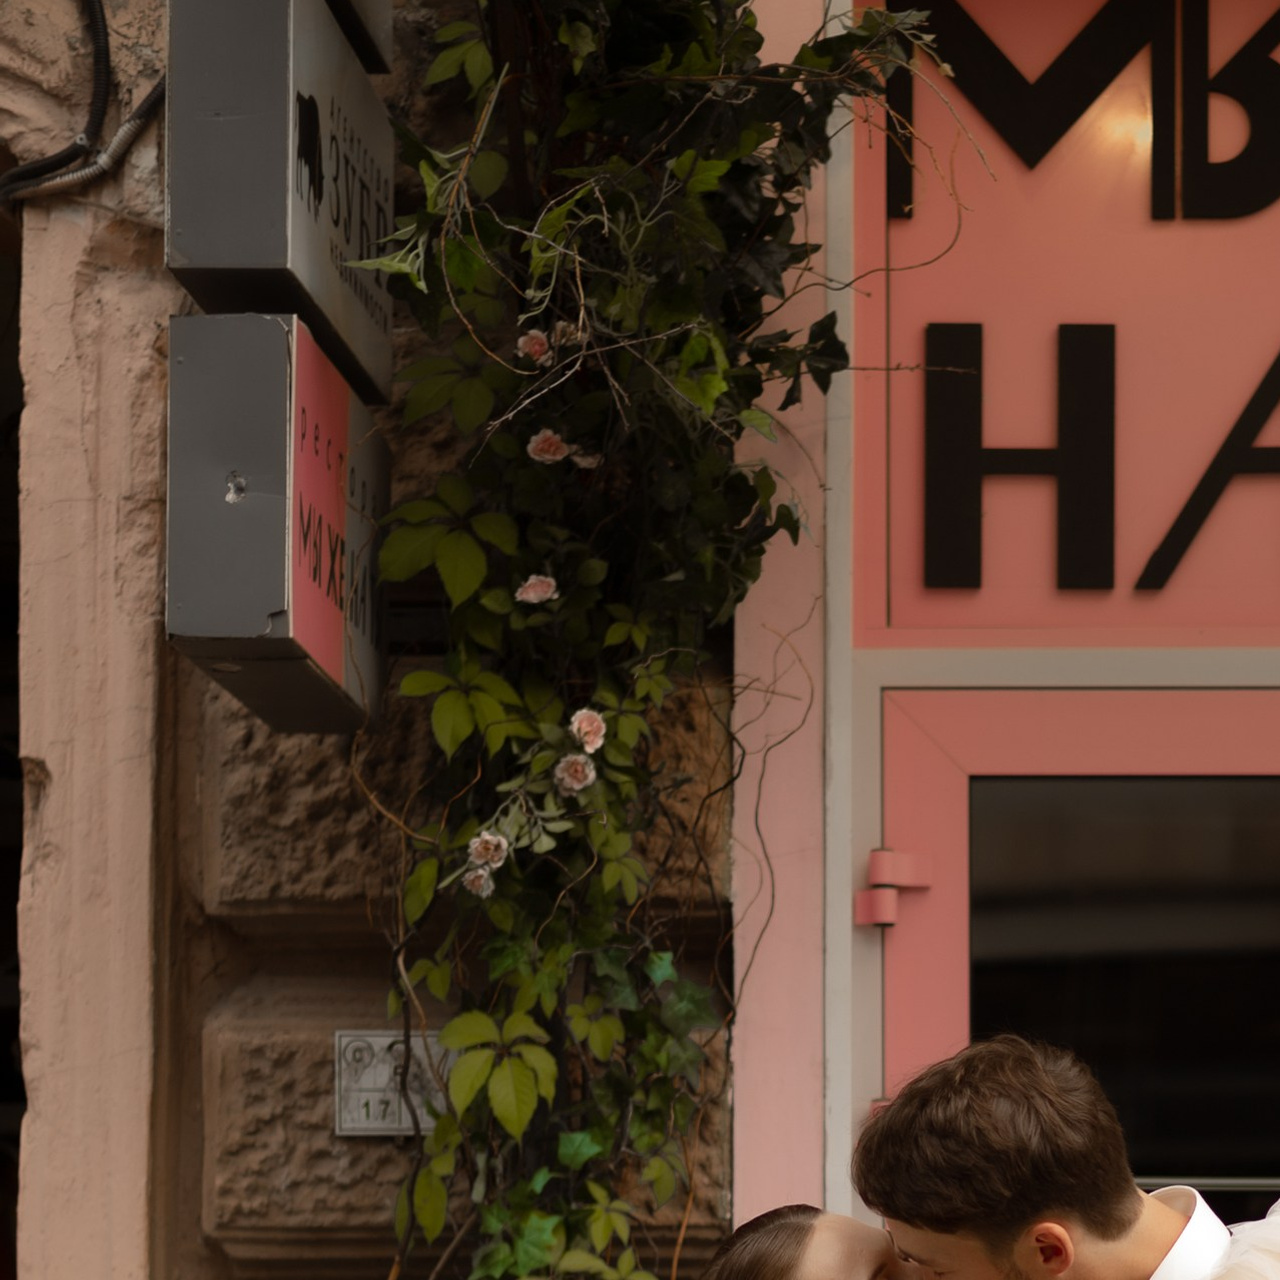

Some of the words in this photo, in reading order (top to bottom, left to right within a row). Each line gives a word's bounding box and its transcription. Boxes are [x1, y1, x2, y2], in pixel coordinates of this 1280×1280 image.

[329, 134, 388, 288] ЗУБР
[326, 523, 345, 612] ЖЕ
[348, 549, 368, 636] НА
